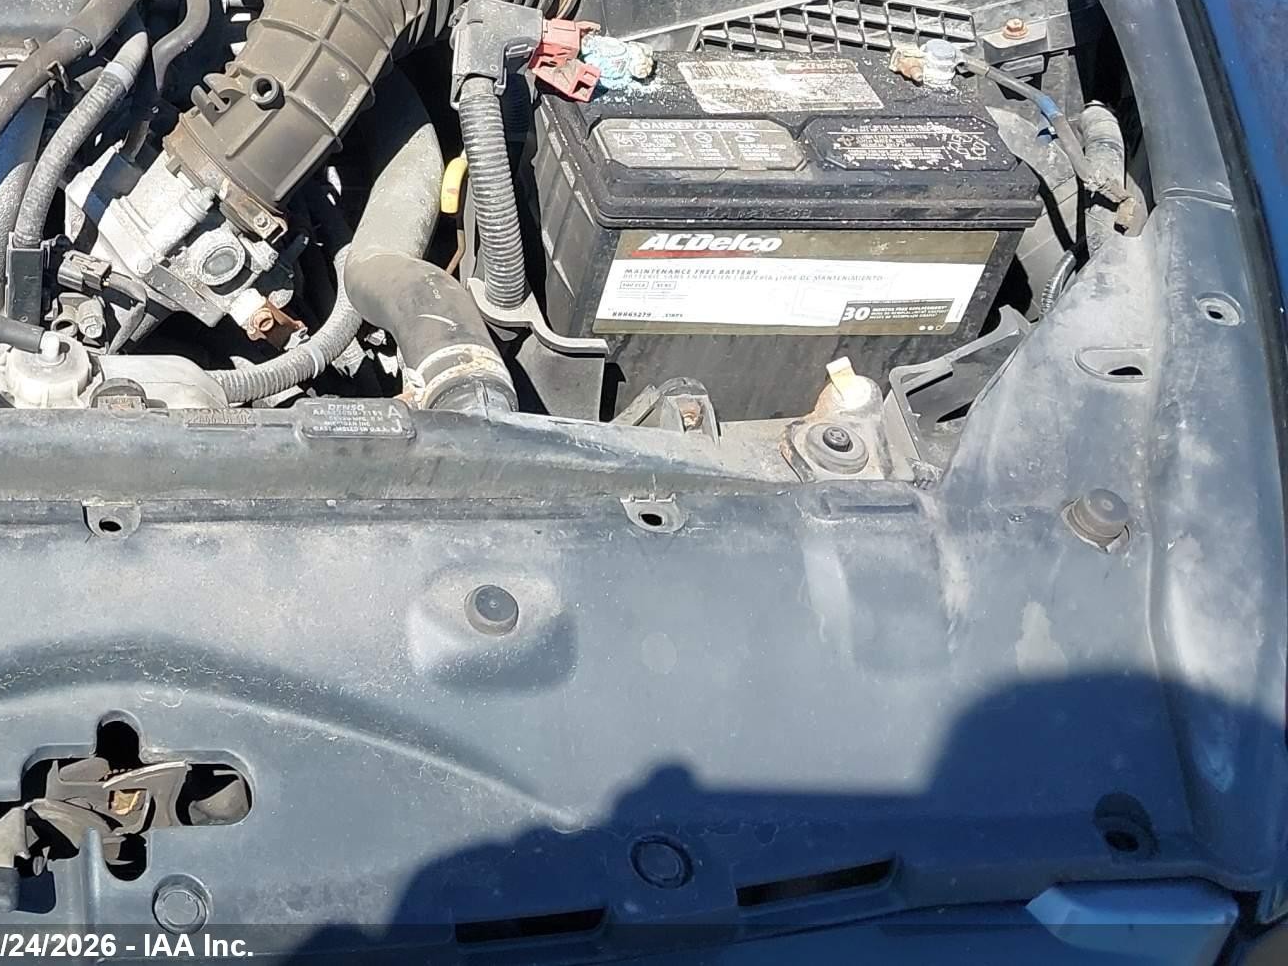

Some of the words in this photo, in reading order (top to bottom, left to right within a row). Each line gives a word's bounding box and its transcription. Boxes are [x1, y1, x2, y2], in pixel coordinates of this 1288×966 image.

[640, 122, 694, 130] DANGER
[705, 122, 755, 130] POISON
[638, 233, 783, 252] ACDelco
[843, 306, 871, 322] 30
